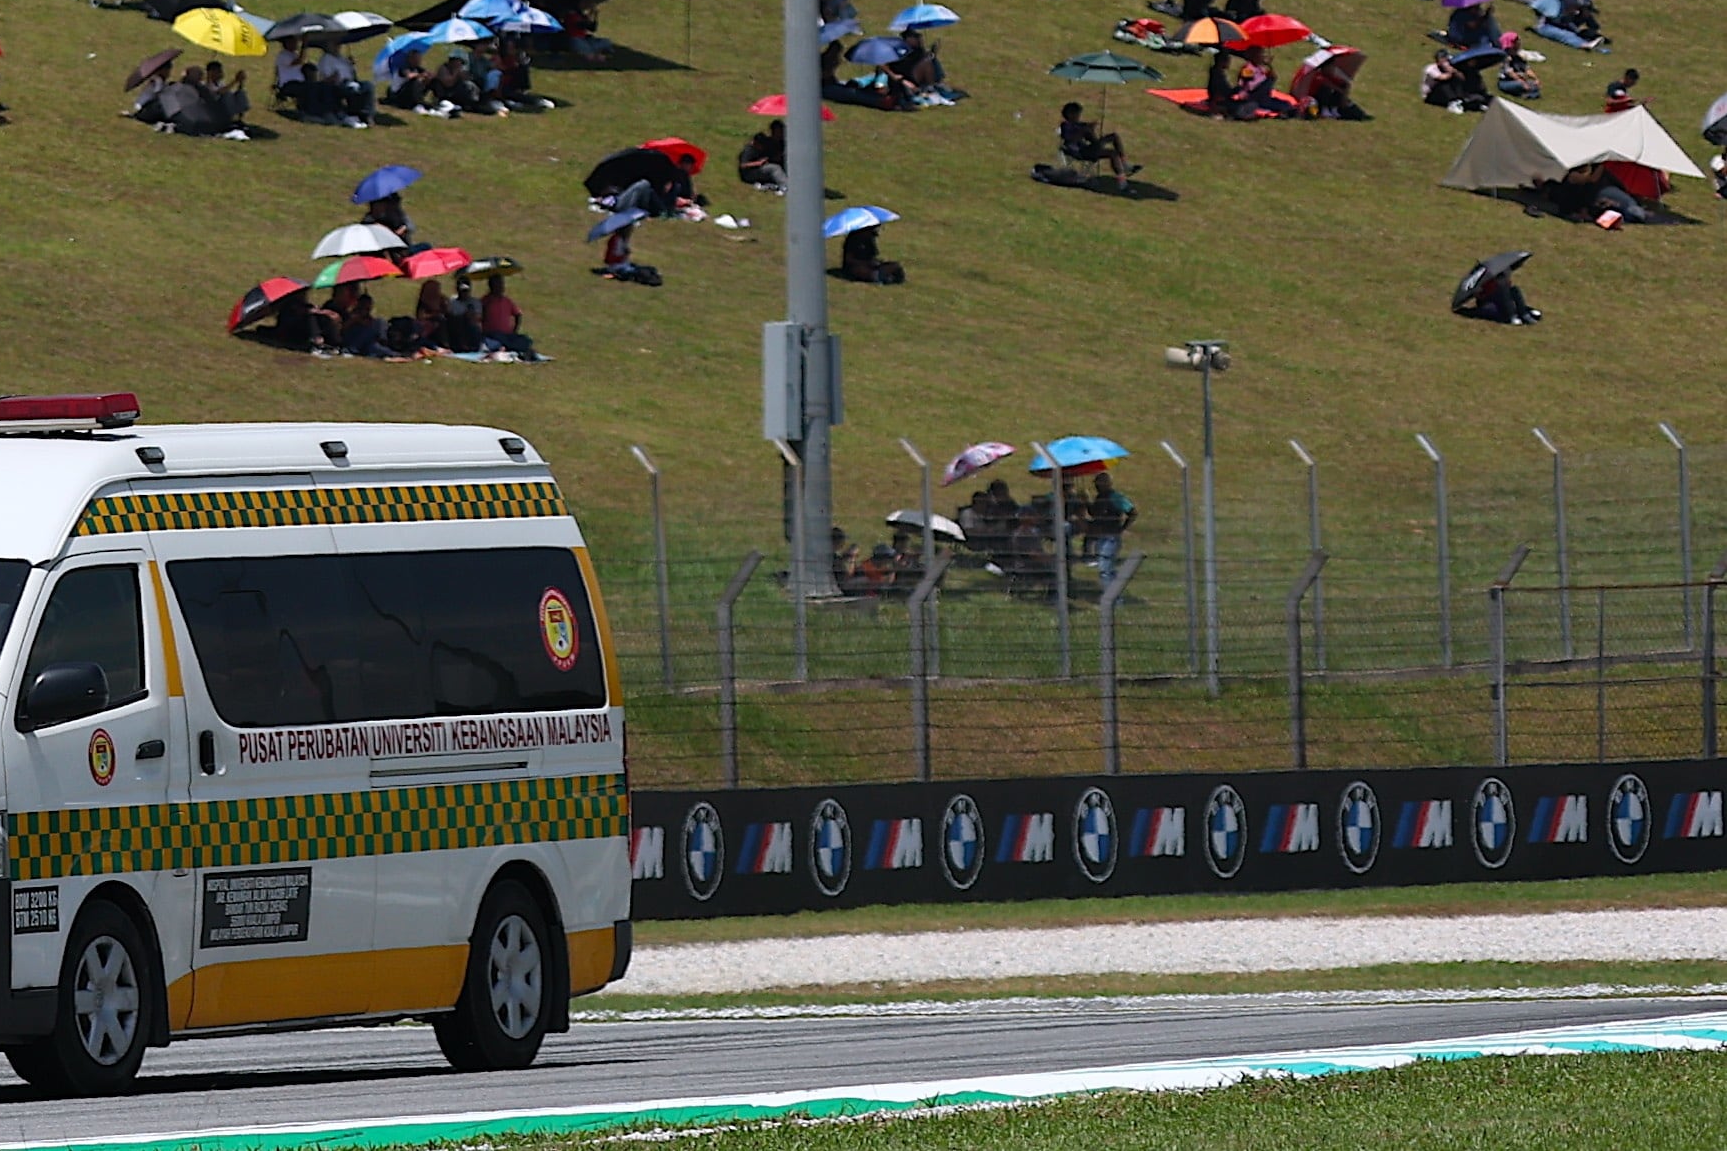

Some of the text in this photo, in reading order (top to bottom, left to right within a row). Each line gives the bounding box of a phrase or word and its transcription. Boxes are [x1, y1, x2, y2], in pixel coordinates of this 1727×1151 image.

[239, 713, 612, 764] PUSAT PERUBATAN UNIVERSITI KEBANGSAAN MALAYSIA
